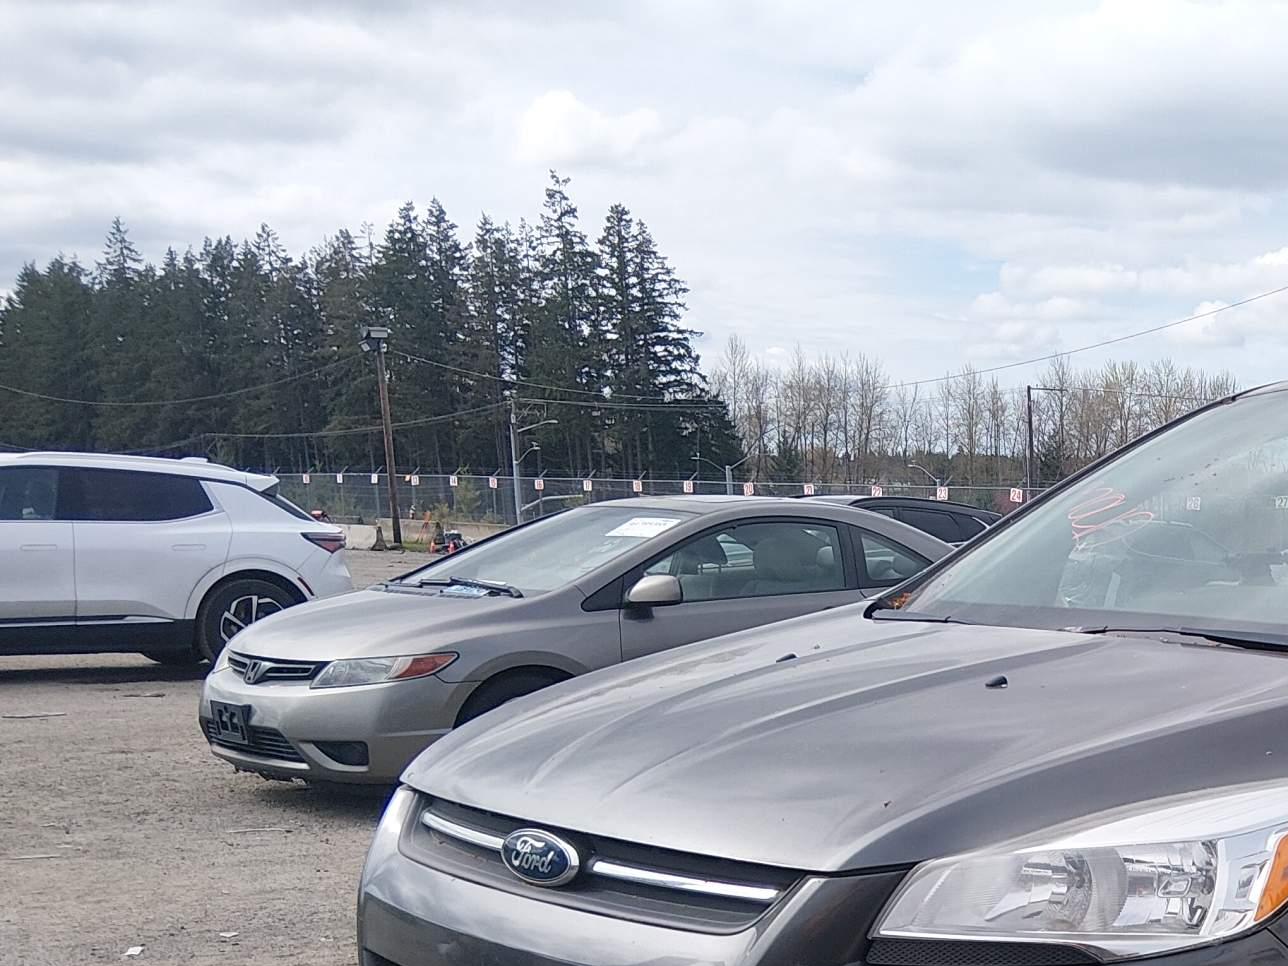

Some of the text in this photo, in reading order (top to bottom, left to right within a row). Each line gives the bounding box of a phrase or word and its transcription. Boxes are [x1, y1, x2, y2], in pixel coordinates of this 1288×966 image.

[744, 483, 753, 495] 20
[872, 487, 881, 497] 22
[938, 488, 947, 499] 23
[1011, 490, 1021, 501] 24
[511, 836, 555, 873] Ford
